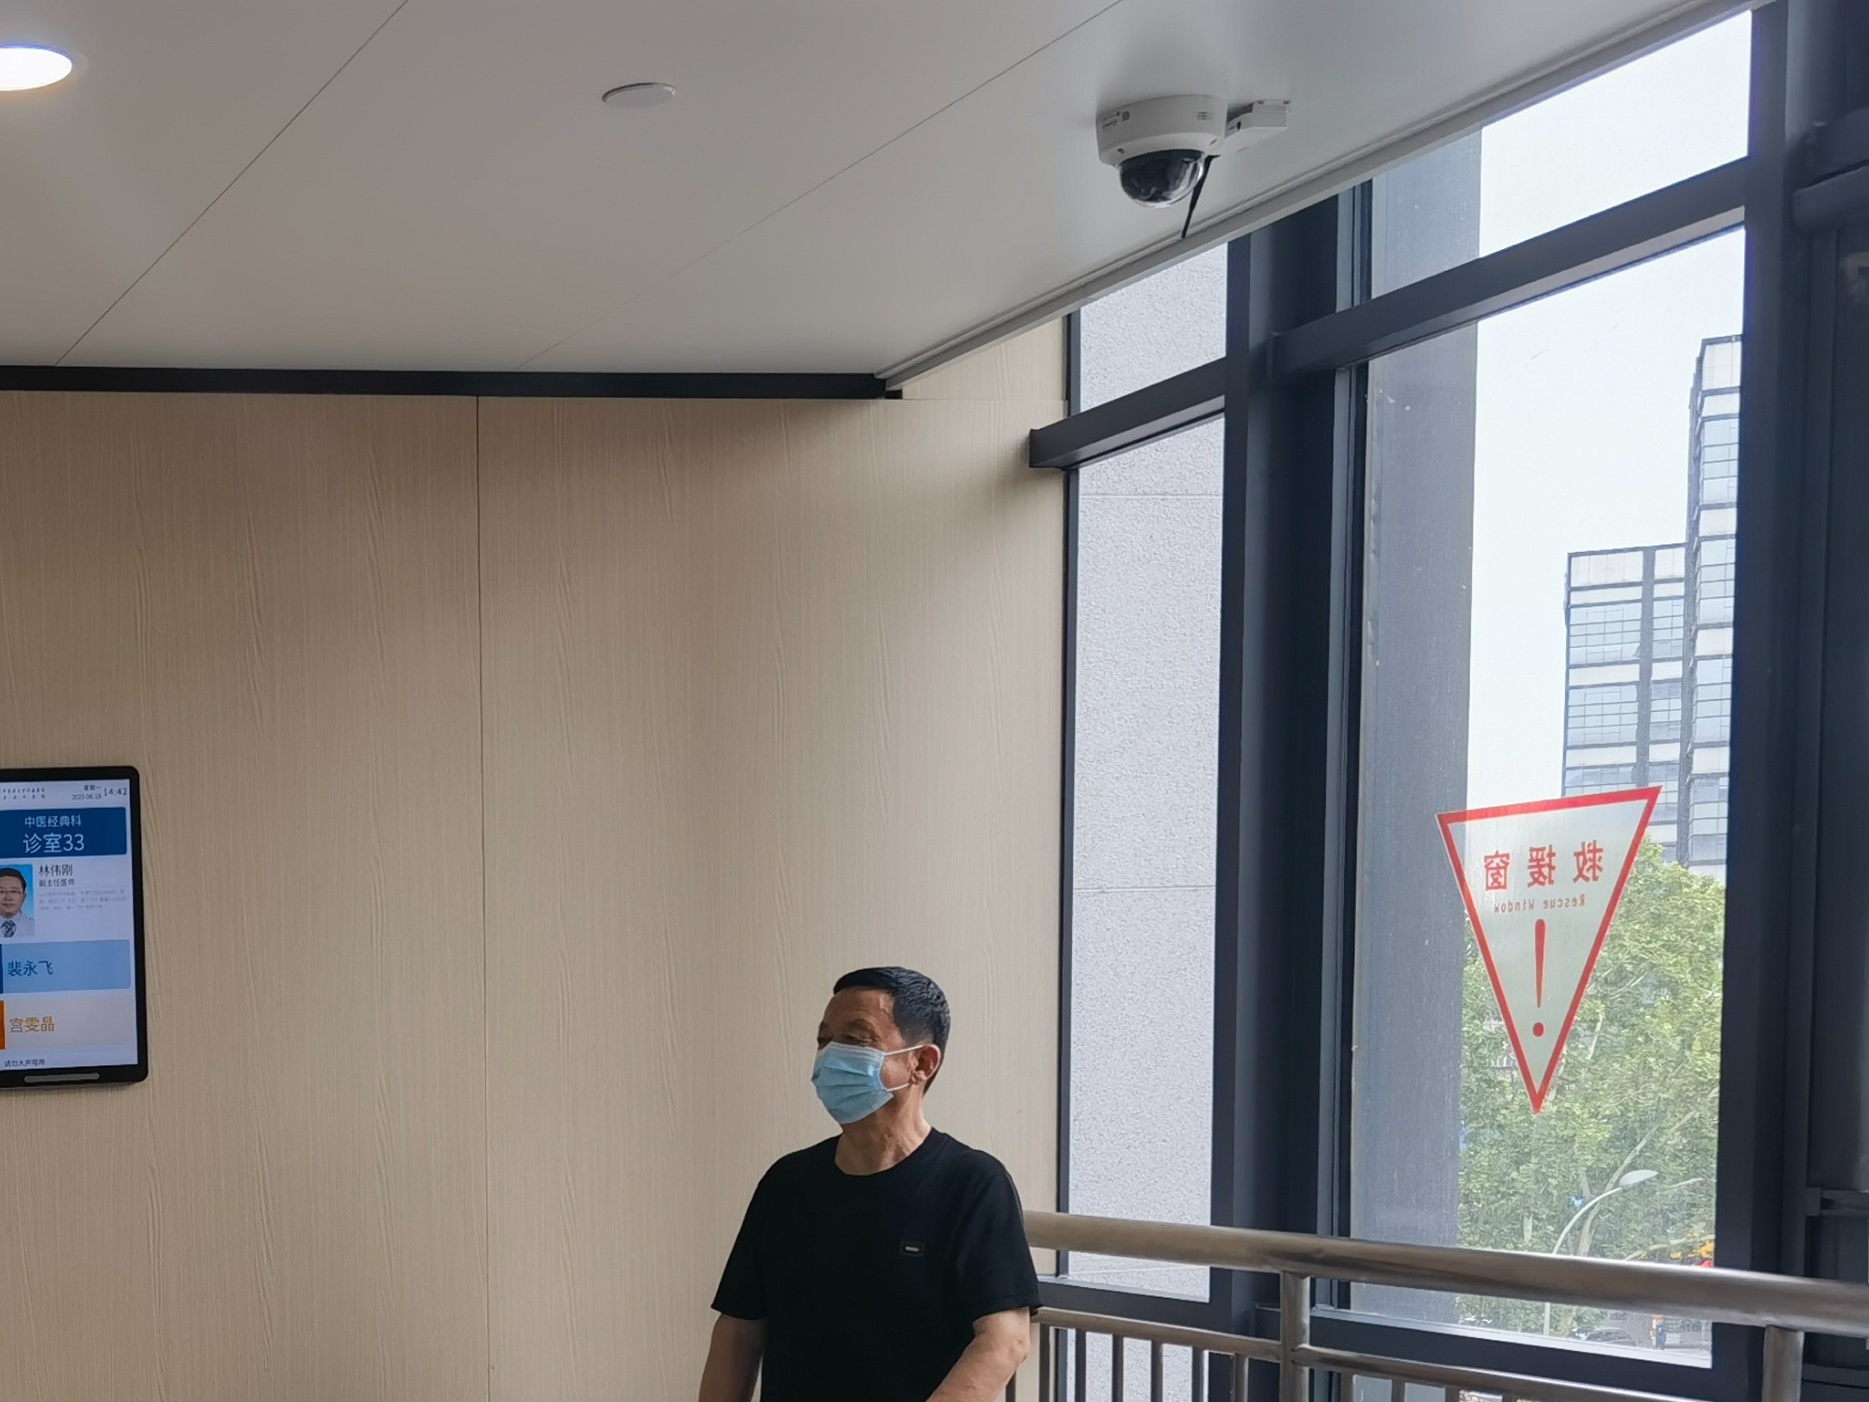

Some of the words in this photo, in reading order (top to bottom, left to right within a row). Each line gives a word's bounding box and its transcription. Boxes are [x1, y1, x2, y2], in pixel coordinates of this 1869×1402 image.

[24, 814, 82, 828] 中医经典科
[22, 832, 85, 854] 诊室33
[7, 960, 54, 977] 裴永飞
